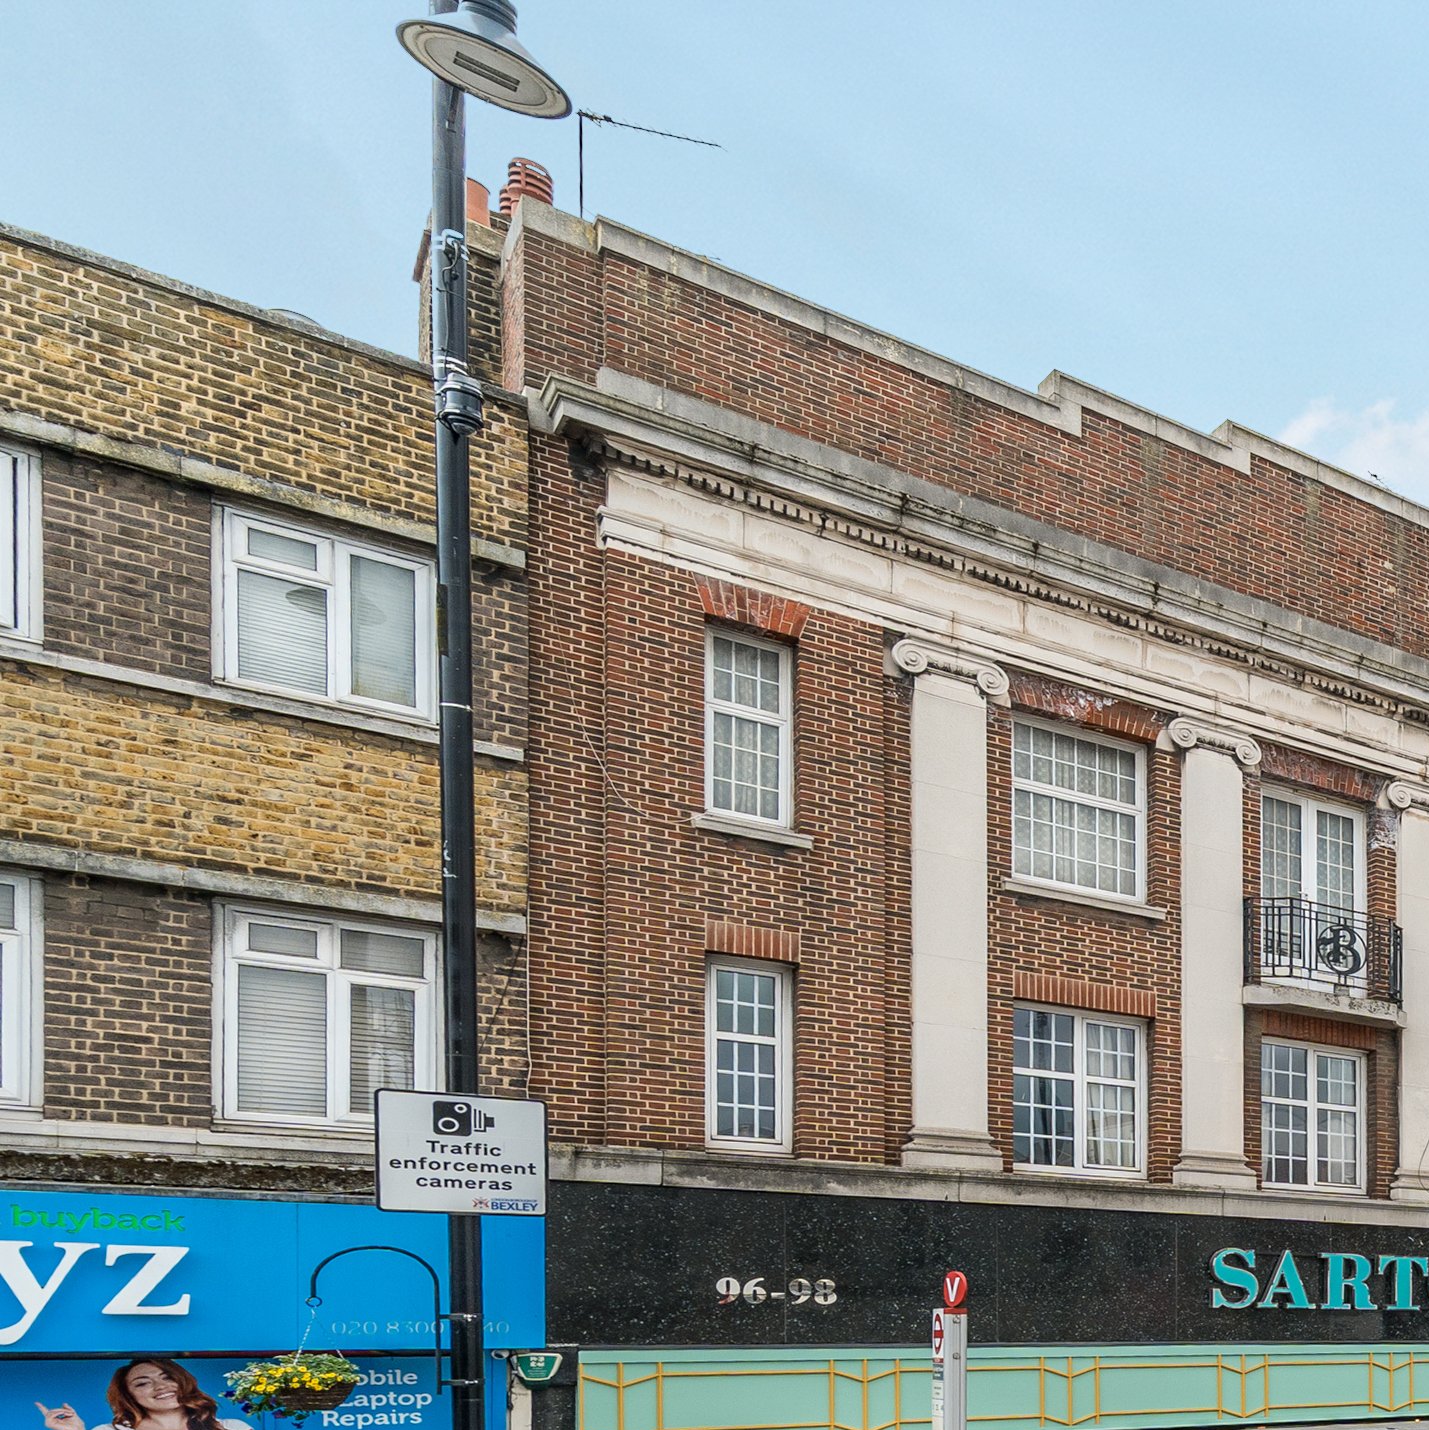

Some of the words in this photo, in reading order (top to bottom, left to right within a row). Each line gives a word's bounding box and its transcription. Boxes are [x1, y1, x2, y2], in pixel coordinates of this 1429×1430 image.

[426, 1140, 501, 1157] Traffic
[389, 1157, 537, 1175] enforcement
[416, 1176, 513, 1191] cameras
[491, 1202, 538, 1211] BEXLEY
[10, 1204, 186, 1234] buyback
[0, 1240, 191, 1345] yz
[716, 1277, 837, 1305] 96-98
[945, 1277, 961, 1302] V
[357, 1369, 418, 1386] obile
[321, 1410, 423, 1429] Repairs
